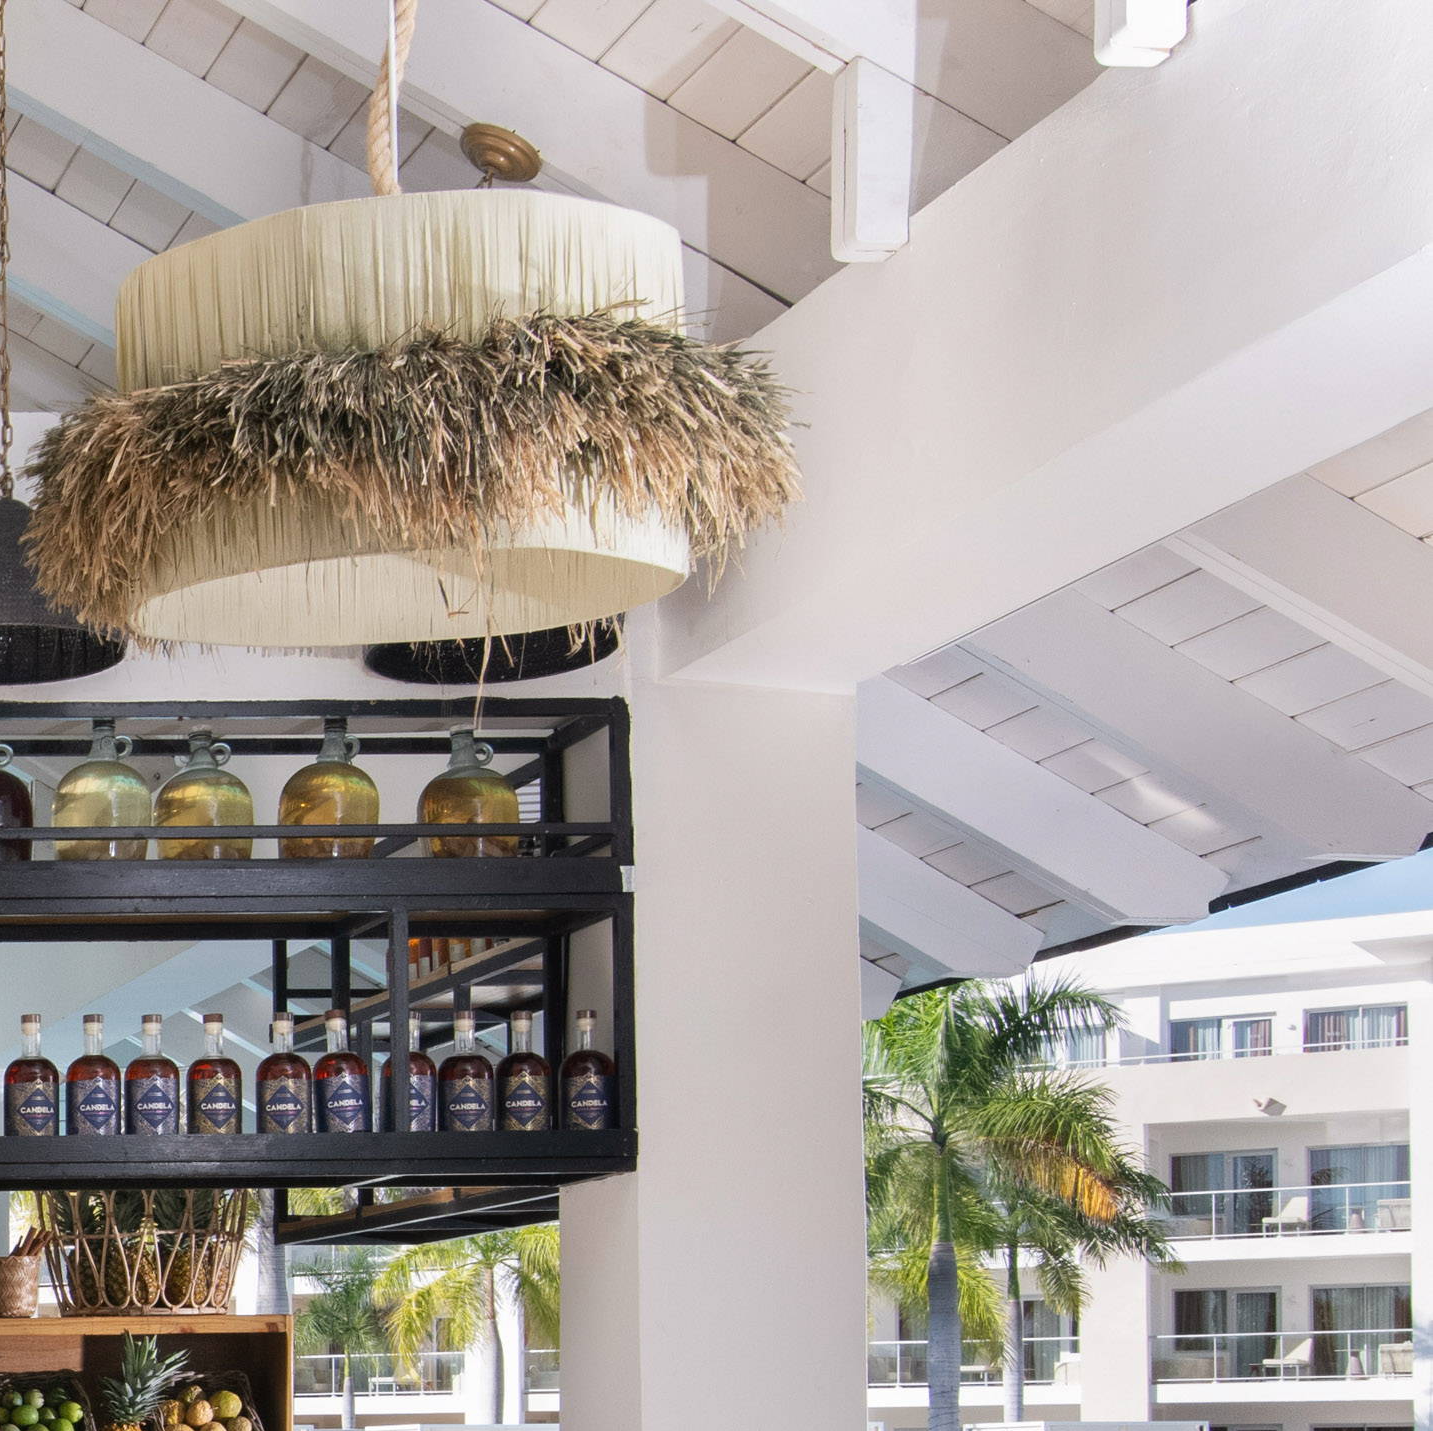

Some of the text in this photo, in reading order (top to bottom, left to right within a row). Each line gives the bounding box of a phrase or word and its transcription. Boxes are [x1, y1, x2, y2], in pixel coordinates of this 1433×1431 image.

[79, 1103, 115, 1112] CANDELA
[137, 1102, 173, 1111] CANDELA
[200, 1102, 236, 1111] CANDELA
[265, 1103, 302, 1113] CANDELA
[327, 1099, 364, 1110] CANDELA
[449, 1102, 486, 1111] CANDELA
[505, 1099, 542, 1109] CANDELA
[570, 1099, 608, 1109] CANDELA
[19, 1105, 55, 1115] CANDELA
